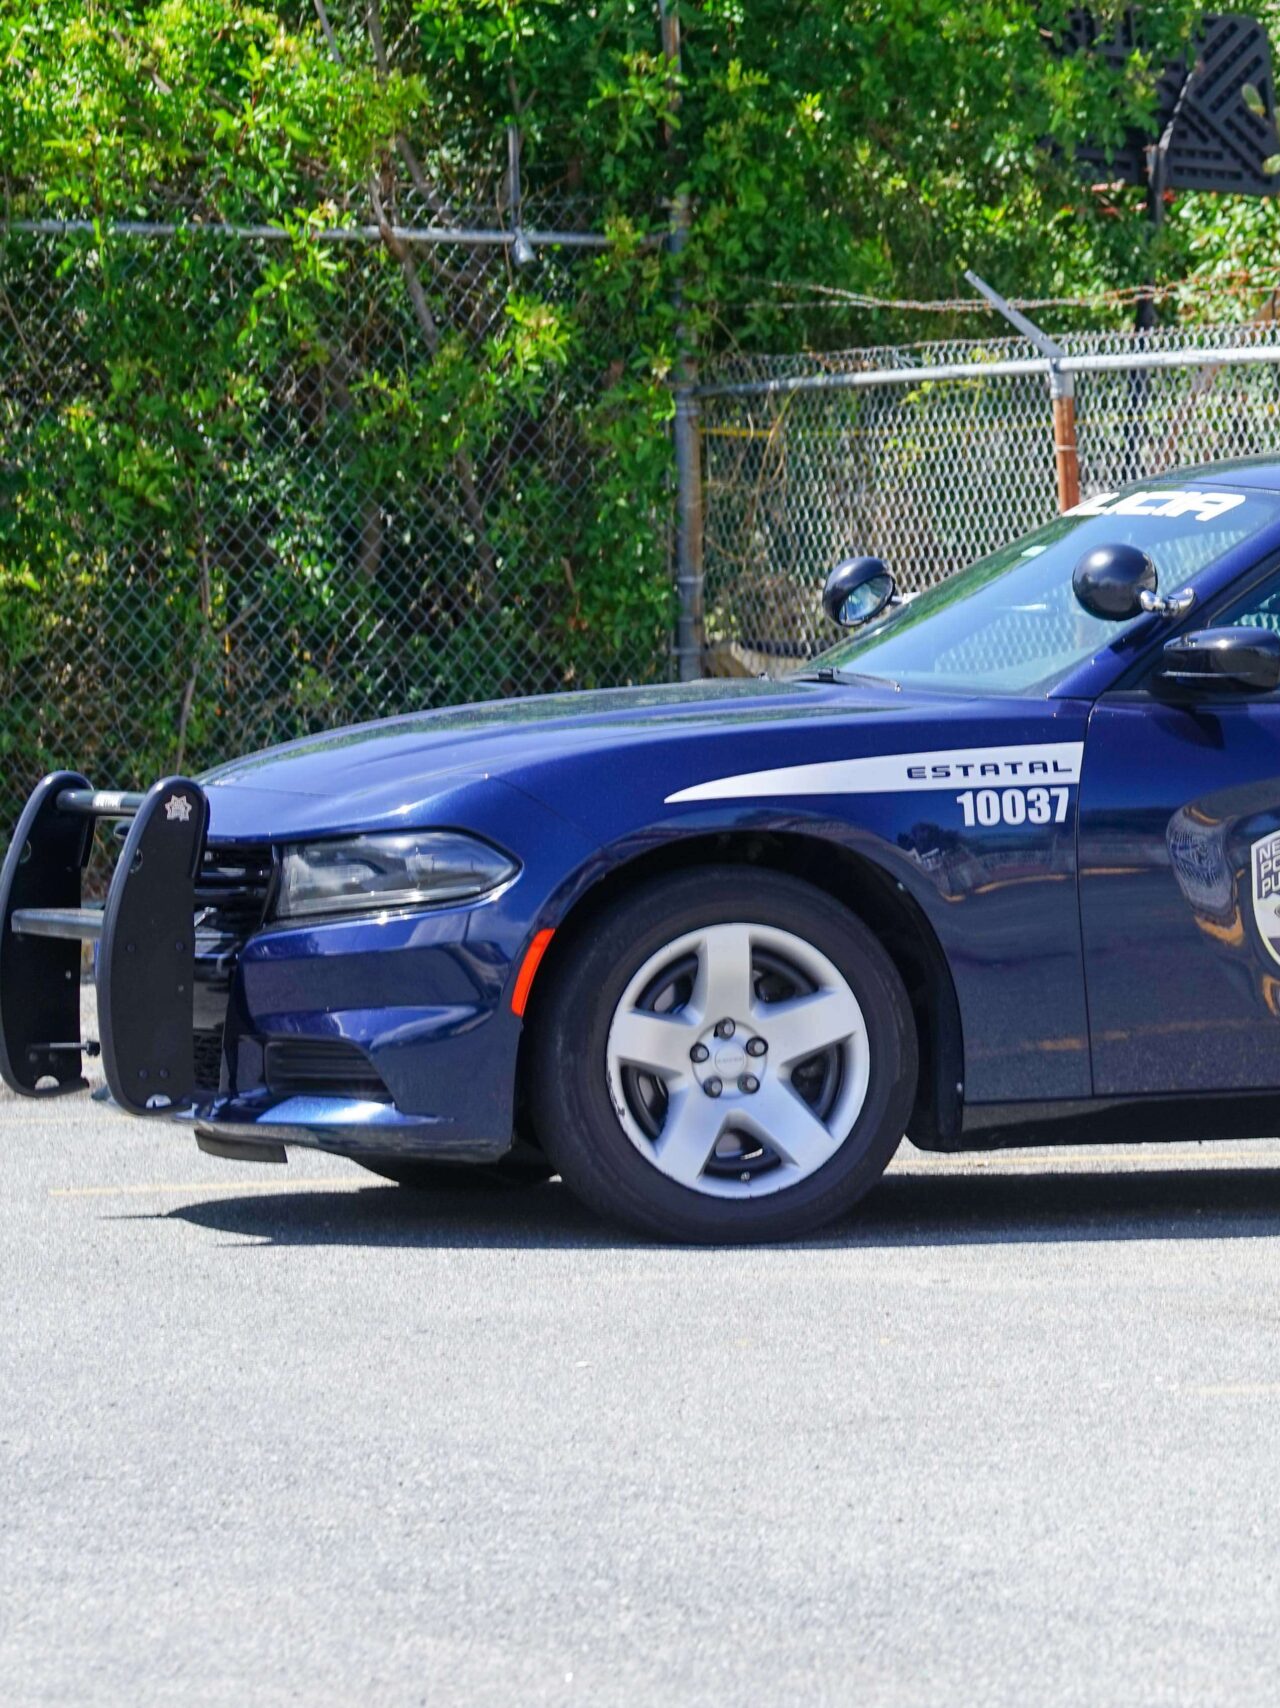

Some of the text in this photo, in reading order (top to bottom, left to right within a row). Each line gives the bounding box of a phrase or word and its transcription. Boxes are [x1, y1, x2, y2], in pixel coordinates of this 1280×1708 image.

[1062, 491, 1246, 521] LICIA
[907, 760, 1072, 779] ESTATAL
[957, 787, 1069, 827] 10037
